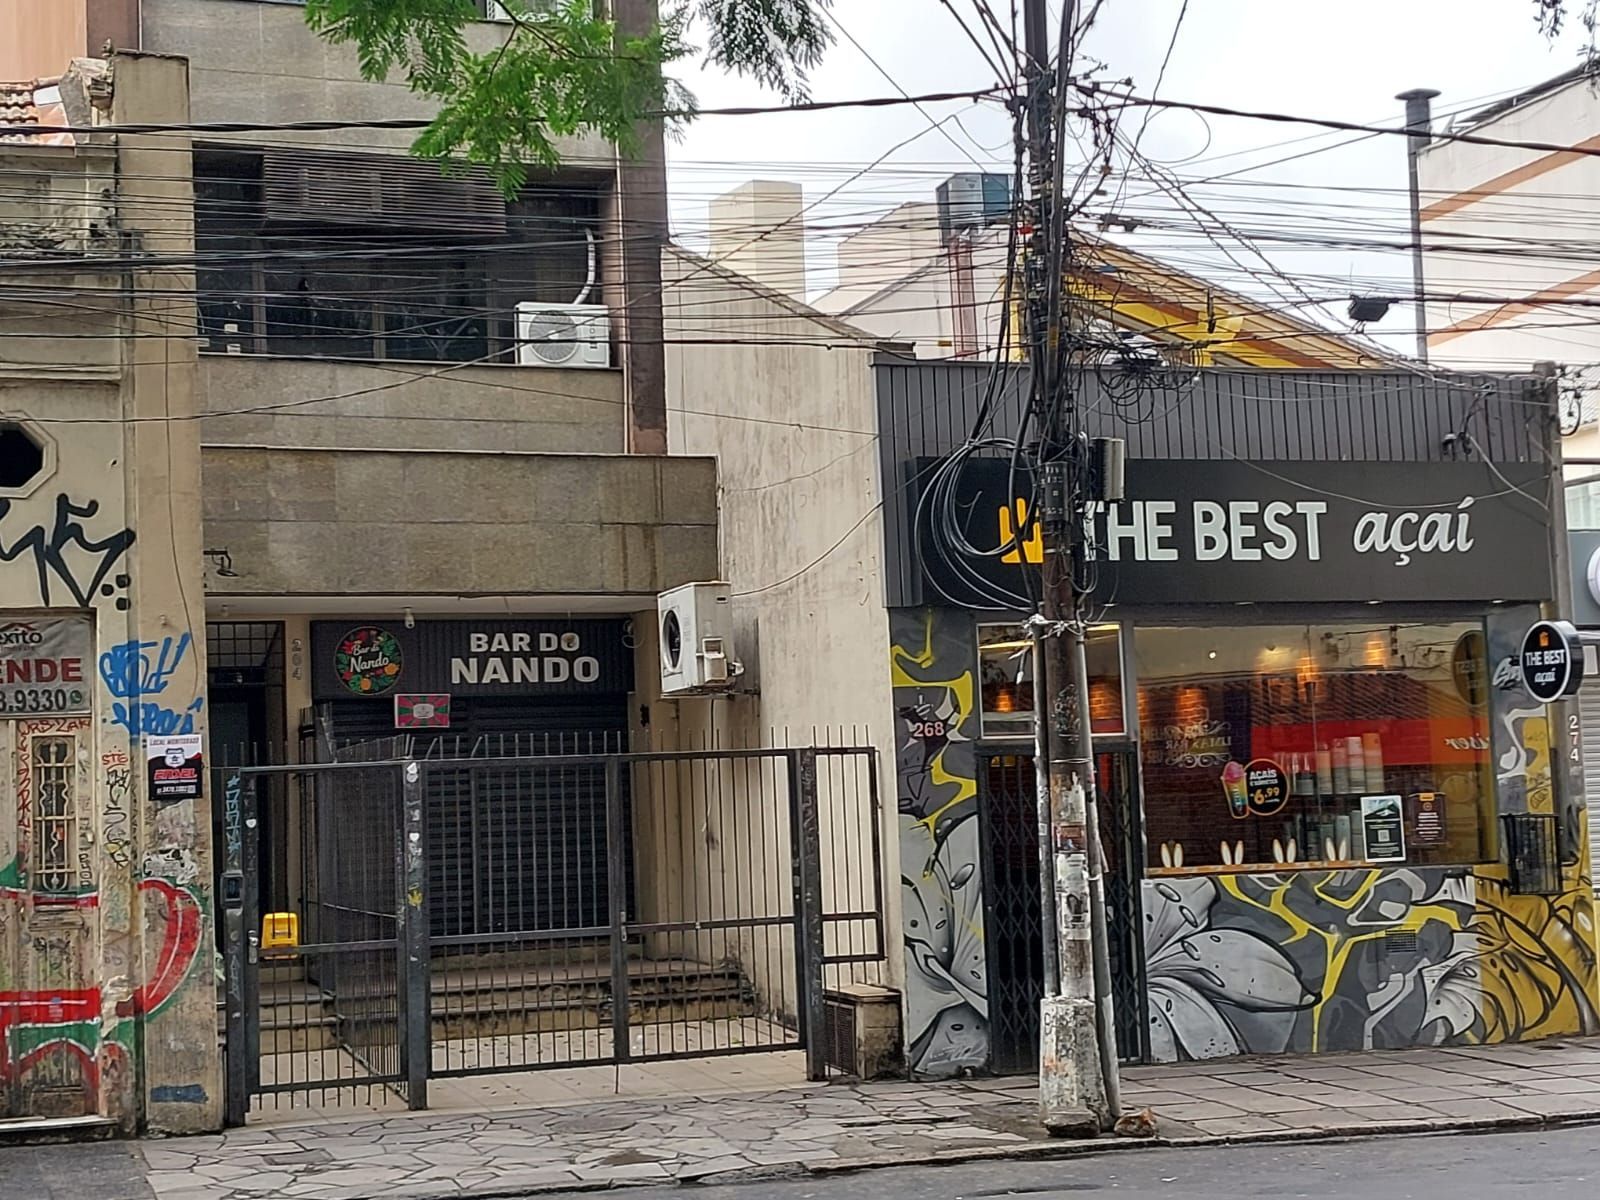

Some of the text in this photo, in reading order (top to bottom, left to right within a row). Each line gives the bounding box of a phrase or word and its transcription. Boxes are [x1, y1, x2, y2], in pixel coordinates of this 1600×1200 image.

[1075, 496, 1475, 566] THE BEST açaí
[470, 632, 581, 653] BAR DO
[350, 652, 389, 673] Nando
[1525, 648, 1566, 667] THE BEST
[451, 656, 600, 685] NANDO
[913, 721, 945, 737] 268
[1568, 715, 1580, 761] 274
